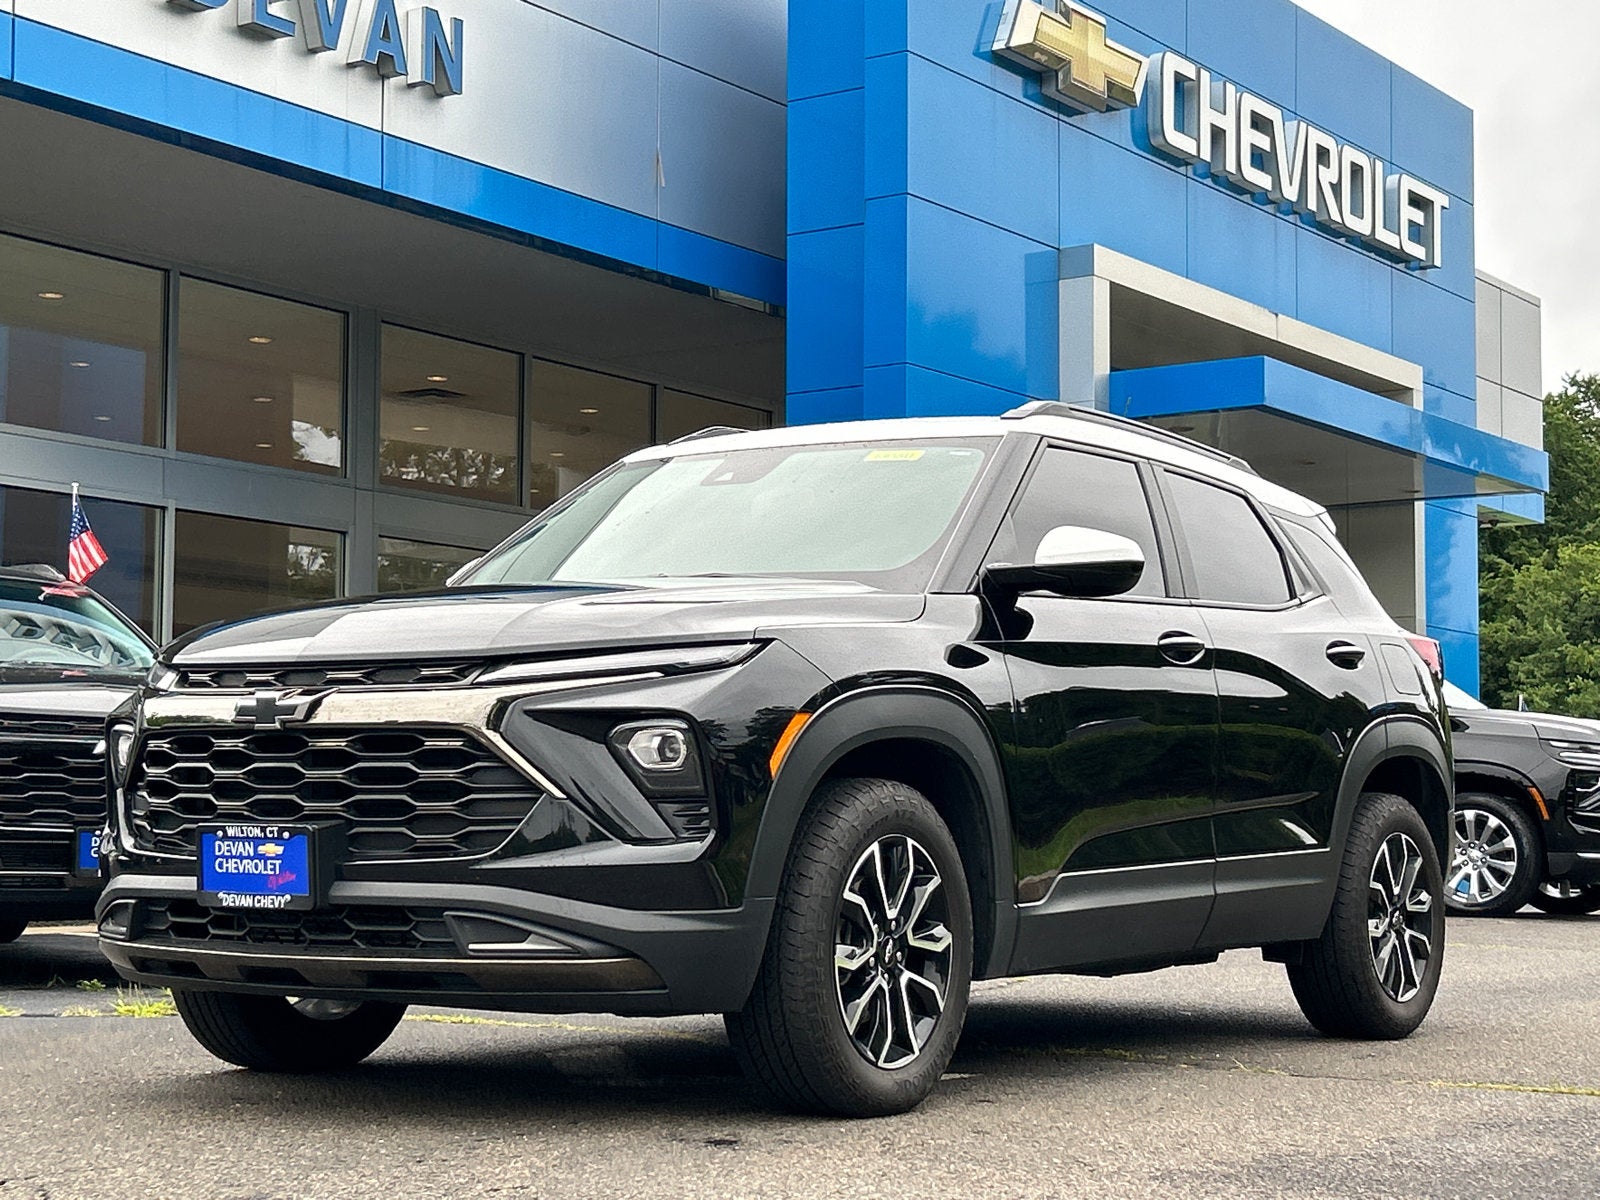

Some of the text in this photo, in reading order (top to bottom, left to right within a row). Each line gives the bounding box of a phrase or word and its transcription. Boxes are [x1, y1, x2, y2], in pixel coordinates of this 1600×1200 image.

[167, 0, 463, 97] VAN
[1149, 50, 1450, 269] CHEVROLET
[266, 826, 279, 838] CT
[214, 841, 254, 857] DEVAN
[214, 858, 282, 875] CHEVROLET
[221, 893, 287, 909] DEVAN CHEVY
